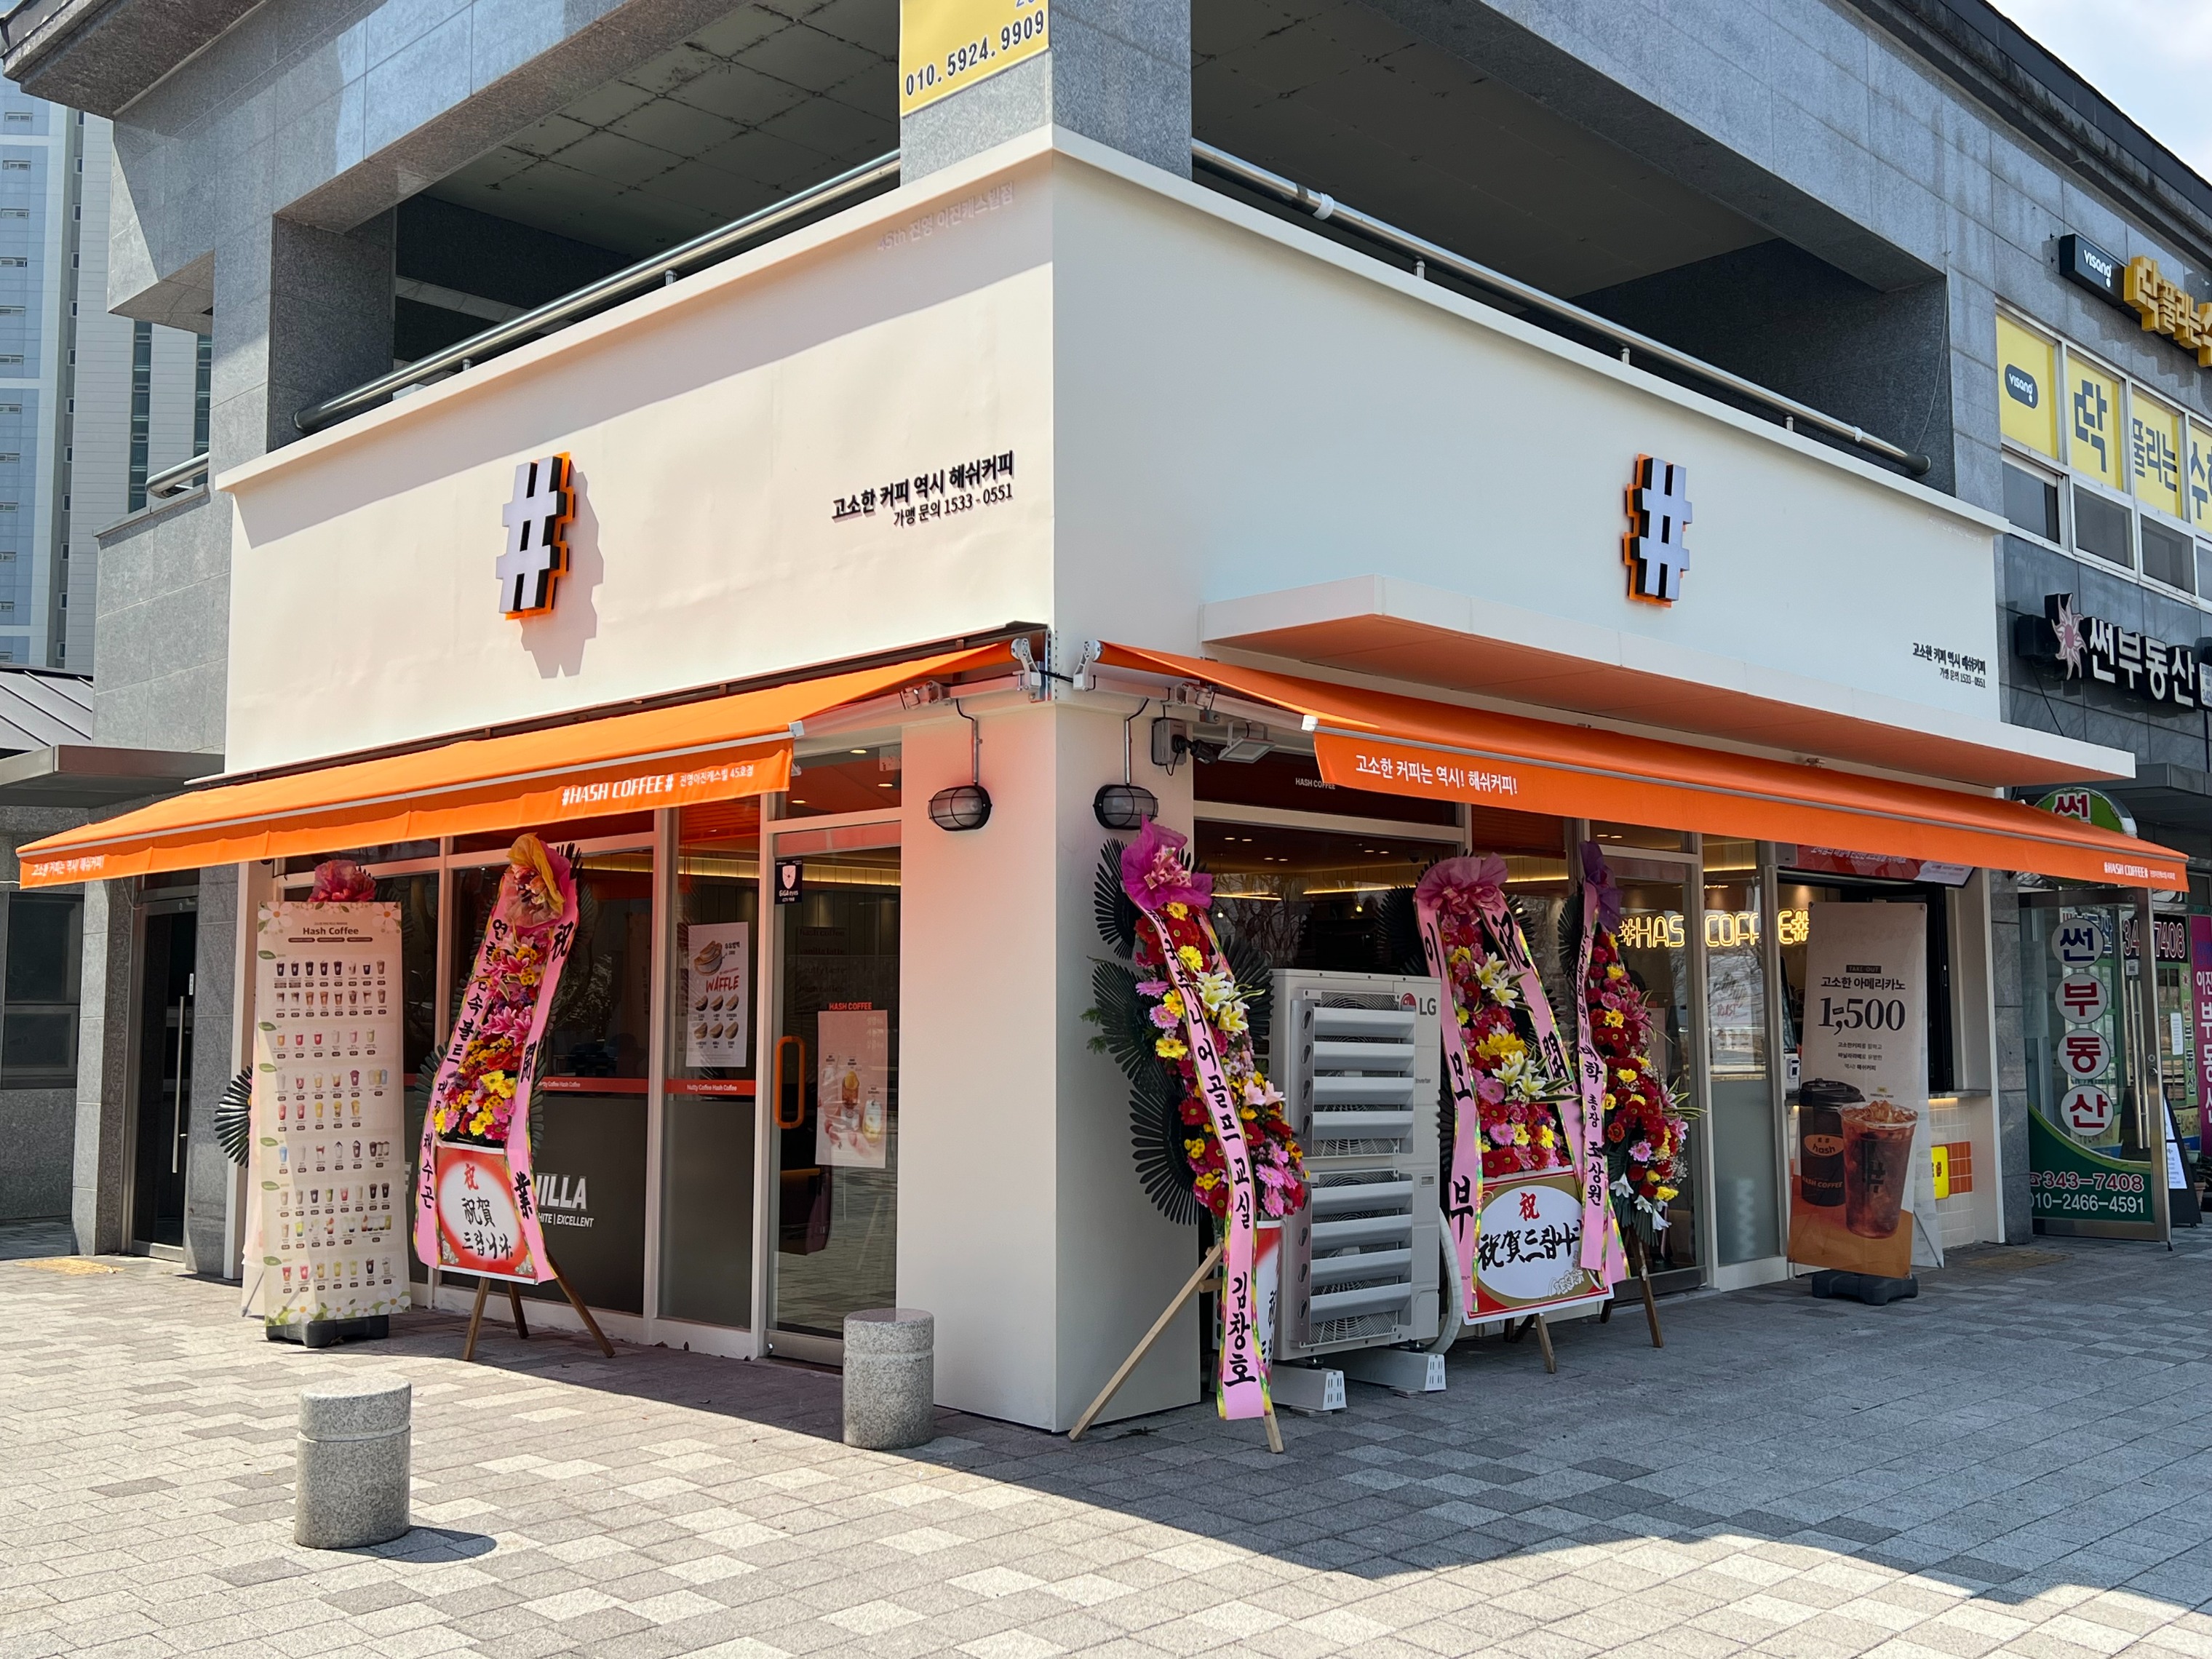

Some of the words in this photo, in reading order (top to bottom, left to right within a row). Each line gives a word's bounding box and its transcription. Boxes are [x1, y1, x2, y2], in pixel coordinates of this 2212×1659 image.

[905, 9, 1045, 96] 010.5924.9909
[832, 488, 875, 520] 고소한
[880, 478, 909, 508] 커피
[913, 469, 944, 498] 역시
[949, 449, 1014, 490] 해쉬커피
[894, 506, 915, 528] 가맹
[918, 500, 941, 522] 문의
[944, 492, 974, 515] 1533
[983, 482, 1014, 505] 0551
[2089, 616, 2195, 707] 썬부동산
[1295, 777, 1313, 787] HASH
[1356, 755, 1393, 779] 고소한
[1396, 760, 1433, 785] 커피는
[1436, 765, 1465, 788] 역시!
[1468, 770, 1519, 796] 해쉬커피!
[303, 927, 326, 935] Hash
[329, 926, 359, 935] Coffee
[706, 974, 741, 992] WAFFLE
[1821, 976, 1853, 990] 고소한
[1854, 977, 1906, 991] 아메리카노
[848, 1002, 872, 1010] COFFEE
[1419, 997, 1437, 1016] LG
[1818, 997, 1906, 1036] 1,500
[1813, 1143, 1836, 1154] hash
[1519, 1192, 1540, 1222] 祝
[557, 1215, 594, 1228] EXCELLENT
[1224, 1271, 1257, 1387] 김창호
